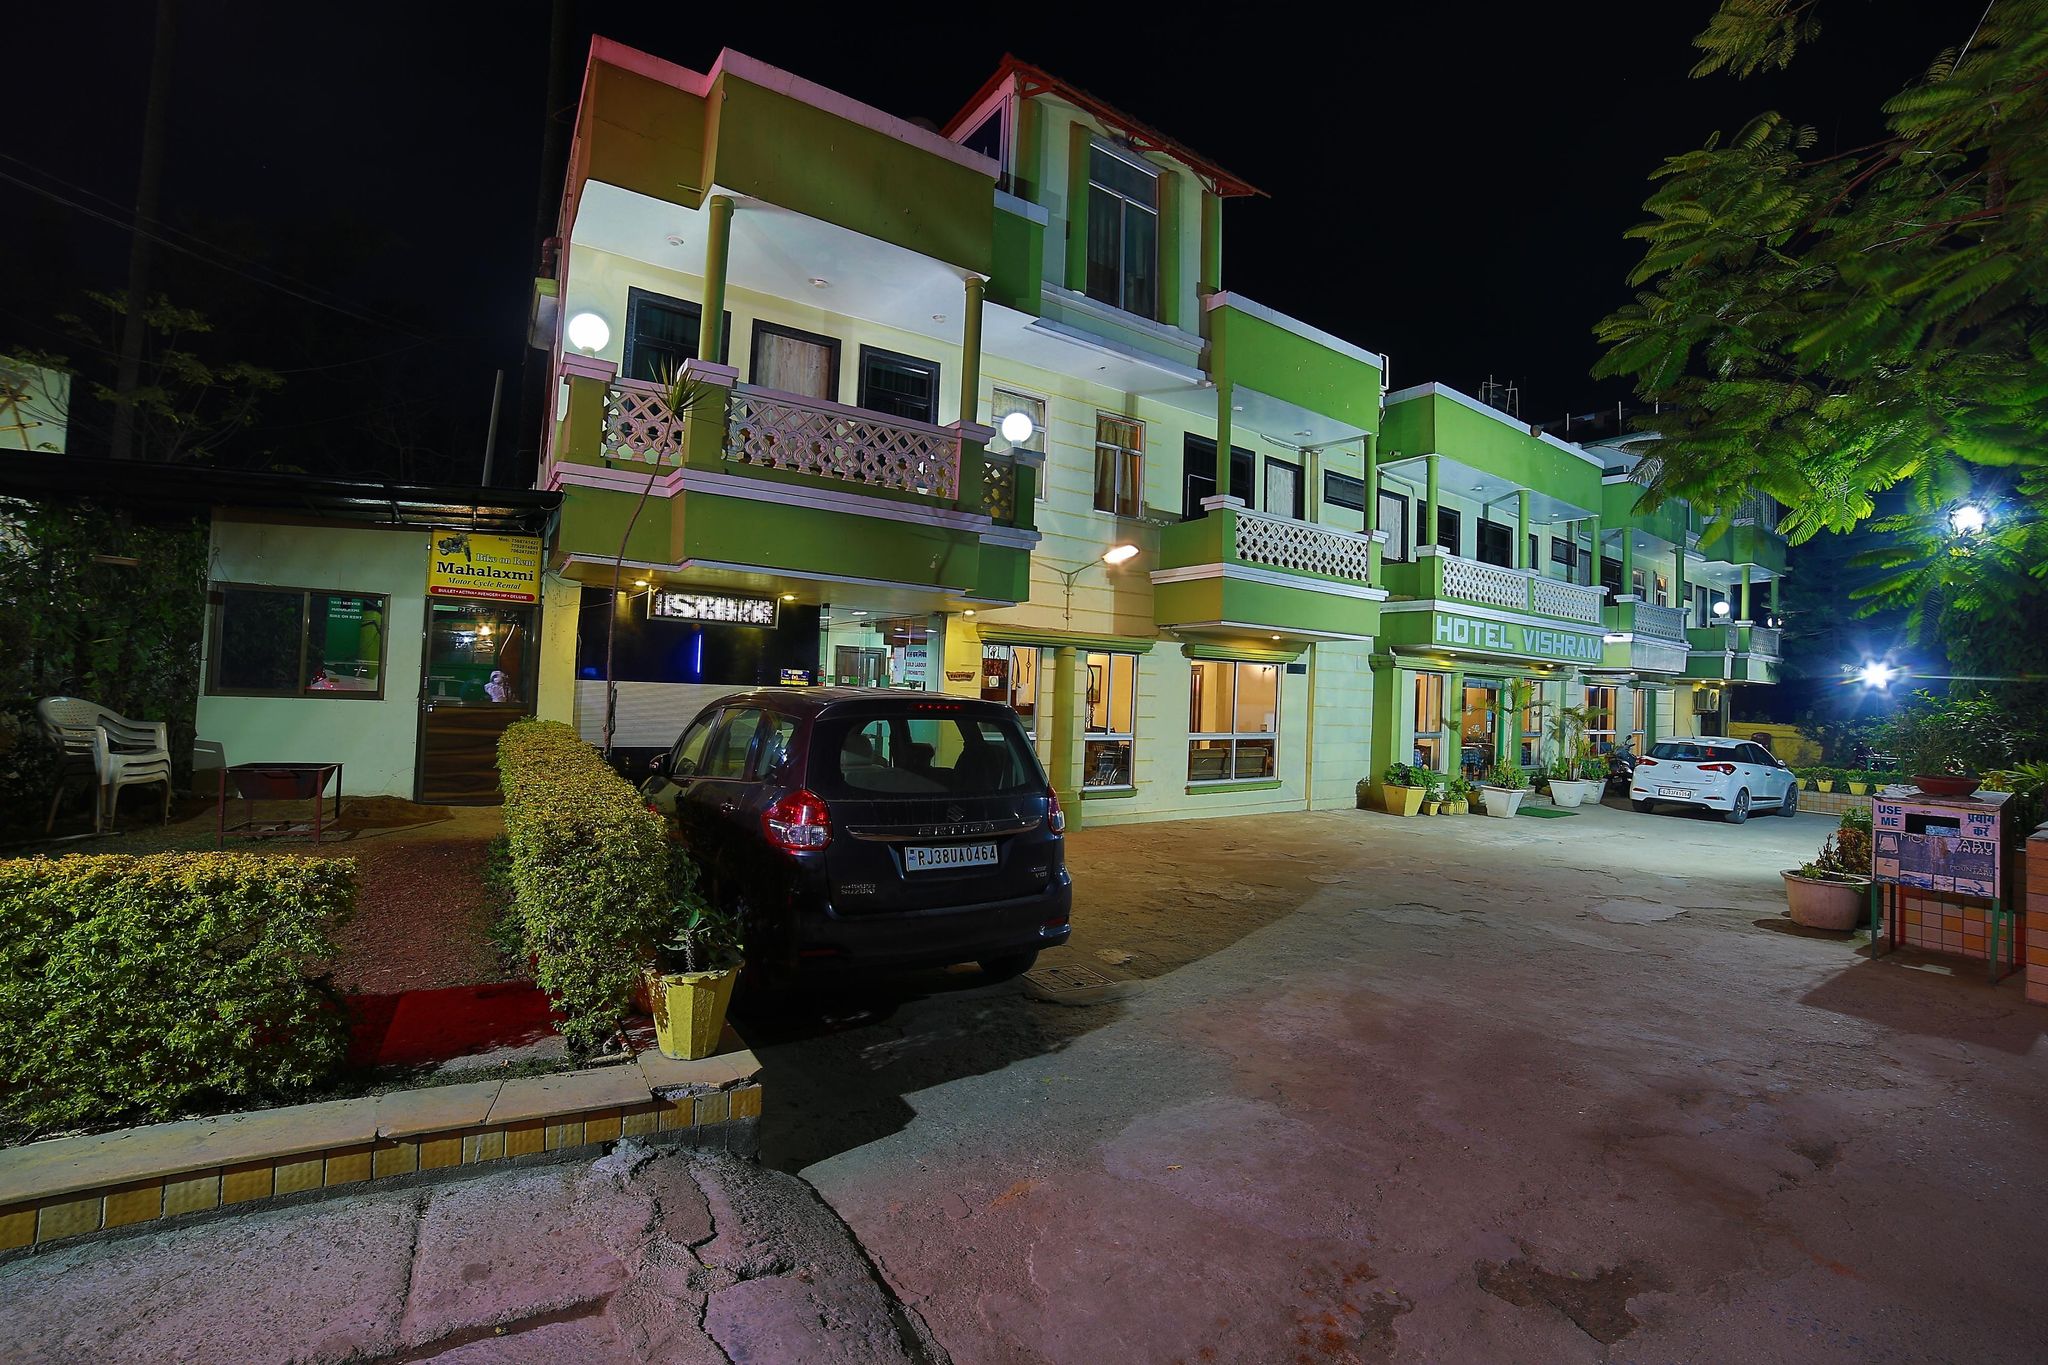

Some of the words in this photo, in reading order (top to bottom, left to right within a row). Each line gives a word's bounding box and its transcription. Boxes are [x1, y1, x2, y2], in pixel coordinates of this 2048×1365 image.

[513, 557, 535, 567] Rent
[436, 561, 534, 581] Mahalaxmi
[448, 577, 471, 585] Motor
[473, 579, 494, 588] Cycle
[496, 581, 521, 590] Rental
[1436, 615, 1513, 650] HOTEL
[1522, 629, 1601, 660] VISHRAM
[1878, 804, 1902, 815] USE
[1881, 817, 1898, 826] ME
[918, 822, 995, 836] ERTIGA
[1973, 825, 1990, 836] करें
[918, 846, 996, 865] RJ38UA0464
